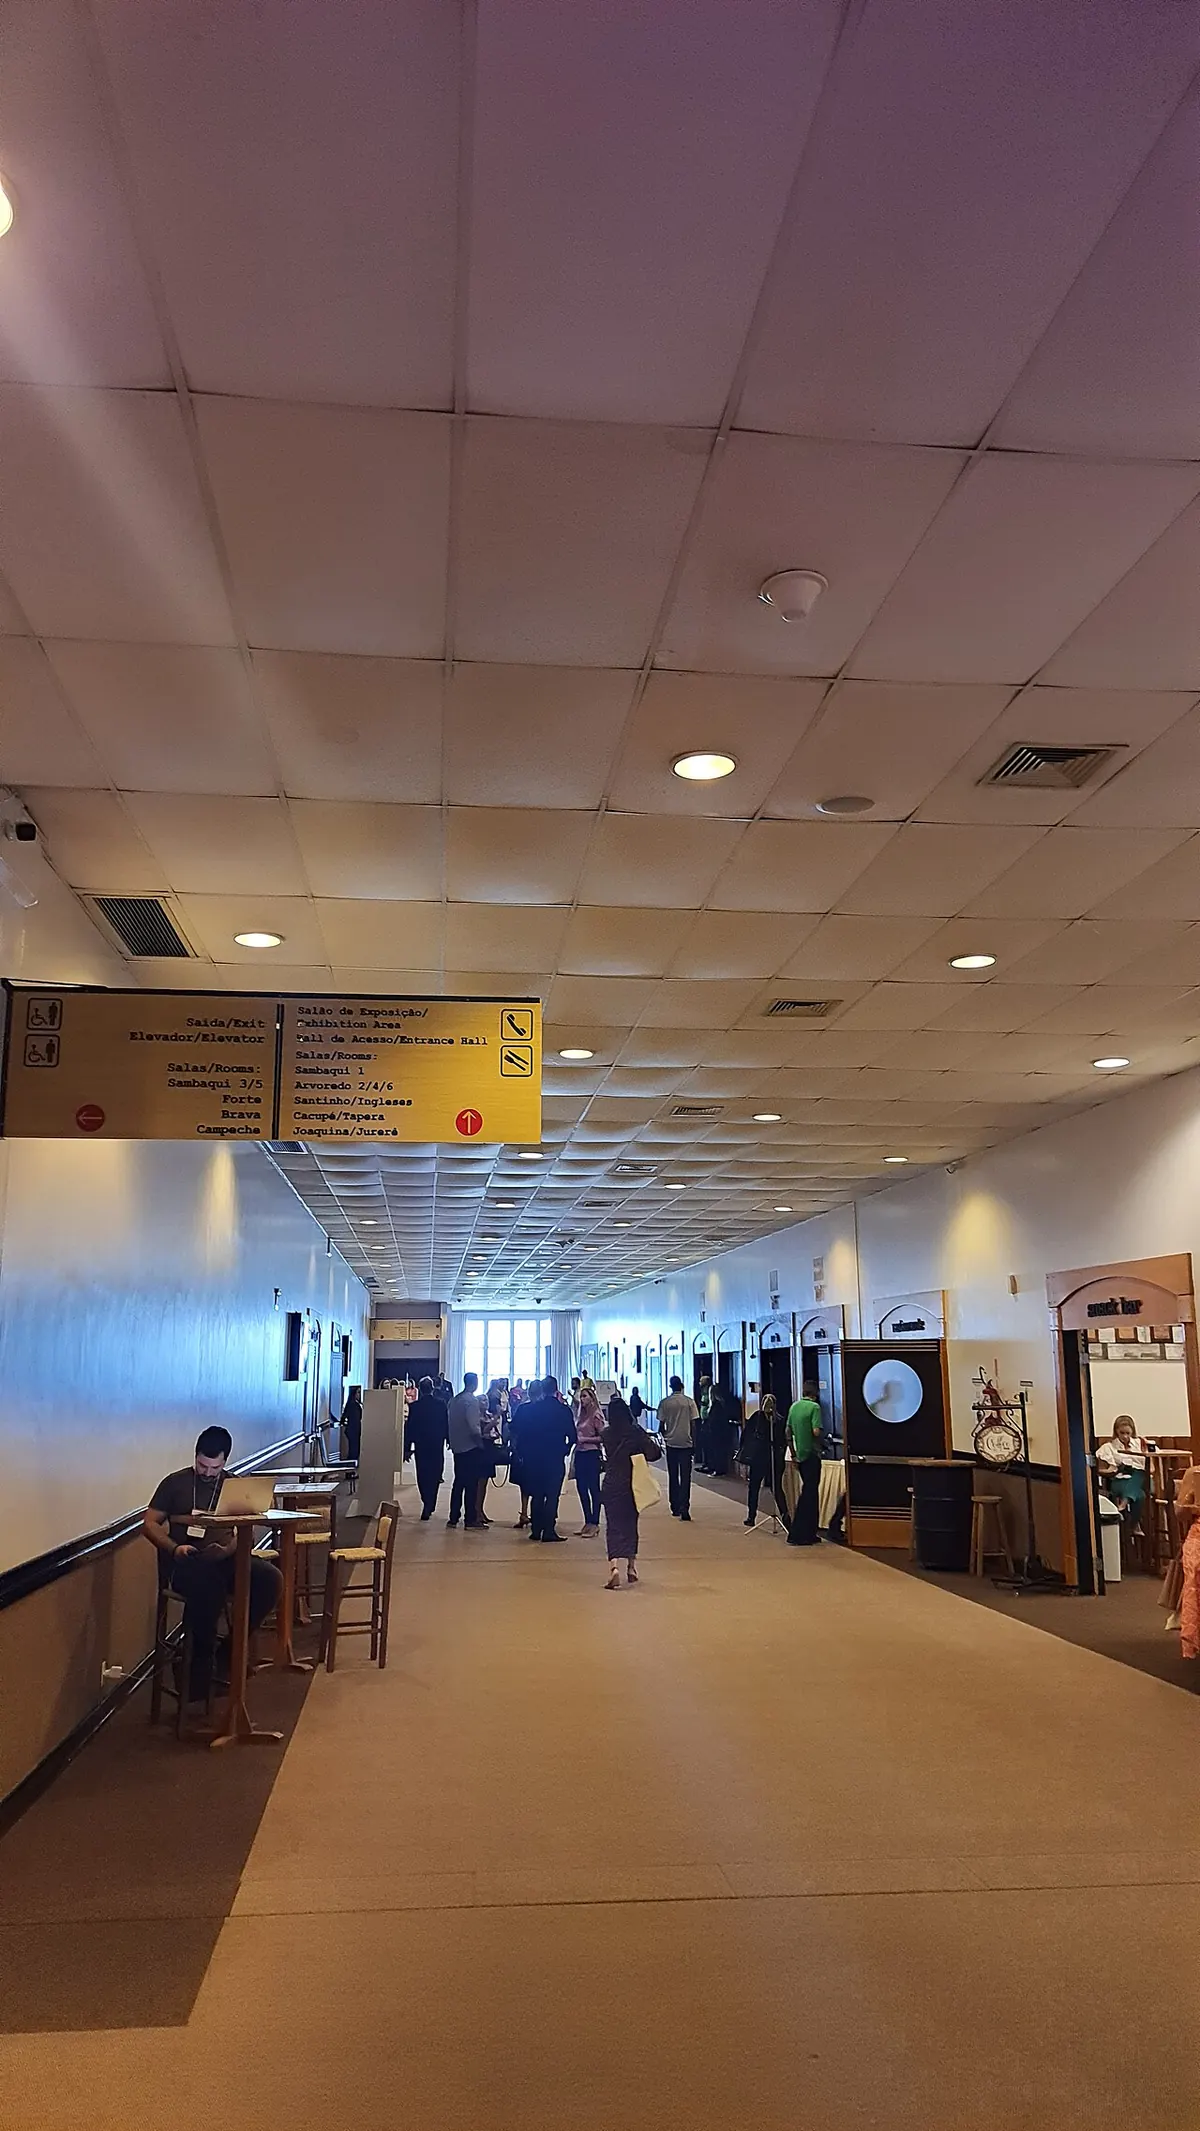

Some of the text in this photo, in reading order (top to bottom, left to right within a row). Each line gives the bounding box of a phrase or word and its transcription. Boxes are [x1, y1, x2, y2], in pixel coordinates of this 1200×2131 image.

[339, 1007, 354, 1016] de
[373, 1020, 402, 1030] Area
[129, 1031, 265, 1044] Elevador/Elevator
[331, 1033, 345, 1044] de
[351, 1034, 454, 1045] Acesso/Entrance
[460, 1036, 488, 1045] Hall
[295, 1050, 378, 1061] Salas/Rooms:
[167, 1062, 261, 1074] Salas/Rooms:
[295, 1065, 365, 1077] Sambaqui 1
[167, 1078, 264, 1091] Sambaqui 3/5
[294, 1081, 394, 1092] Arvoredo 2/4/6
[222, 1094, 262, 1104] Forte
[293, 1096, 413, 1108] Santinho/Ingleses
[221, 1109, 261, 1119] Brava
[293, 1110, 385, 1123] Cacupé/Tapera
[196, 1124, 261, 1136] Campeche
[1119, 1296, 1143, 1315] bar
